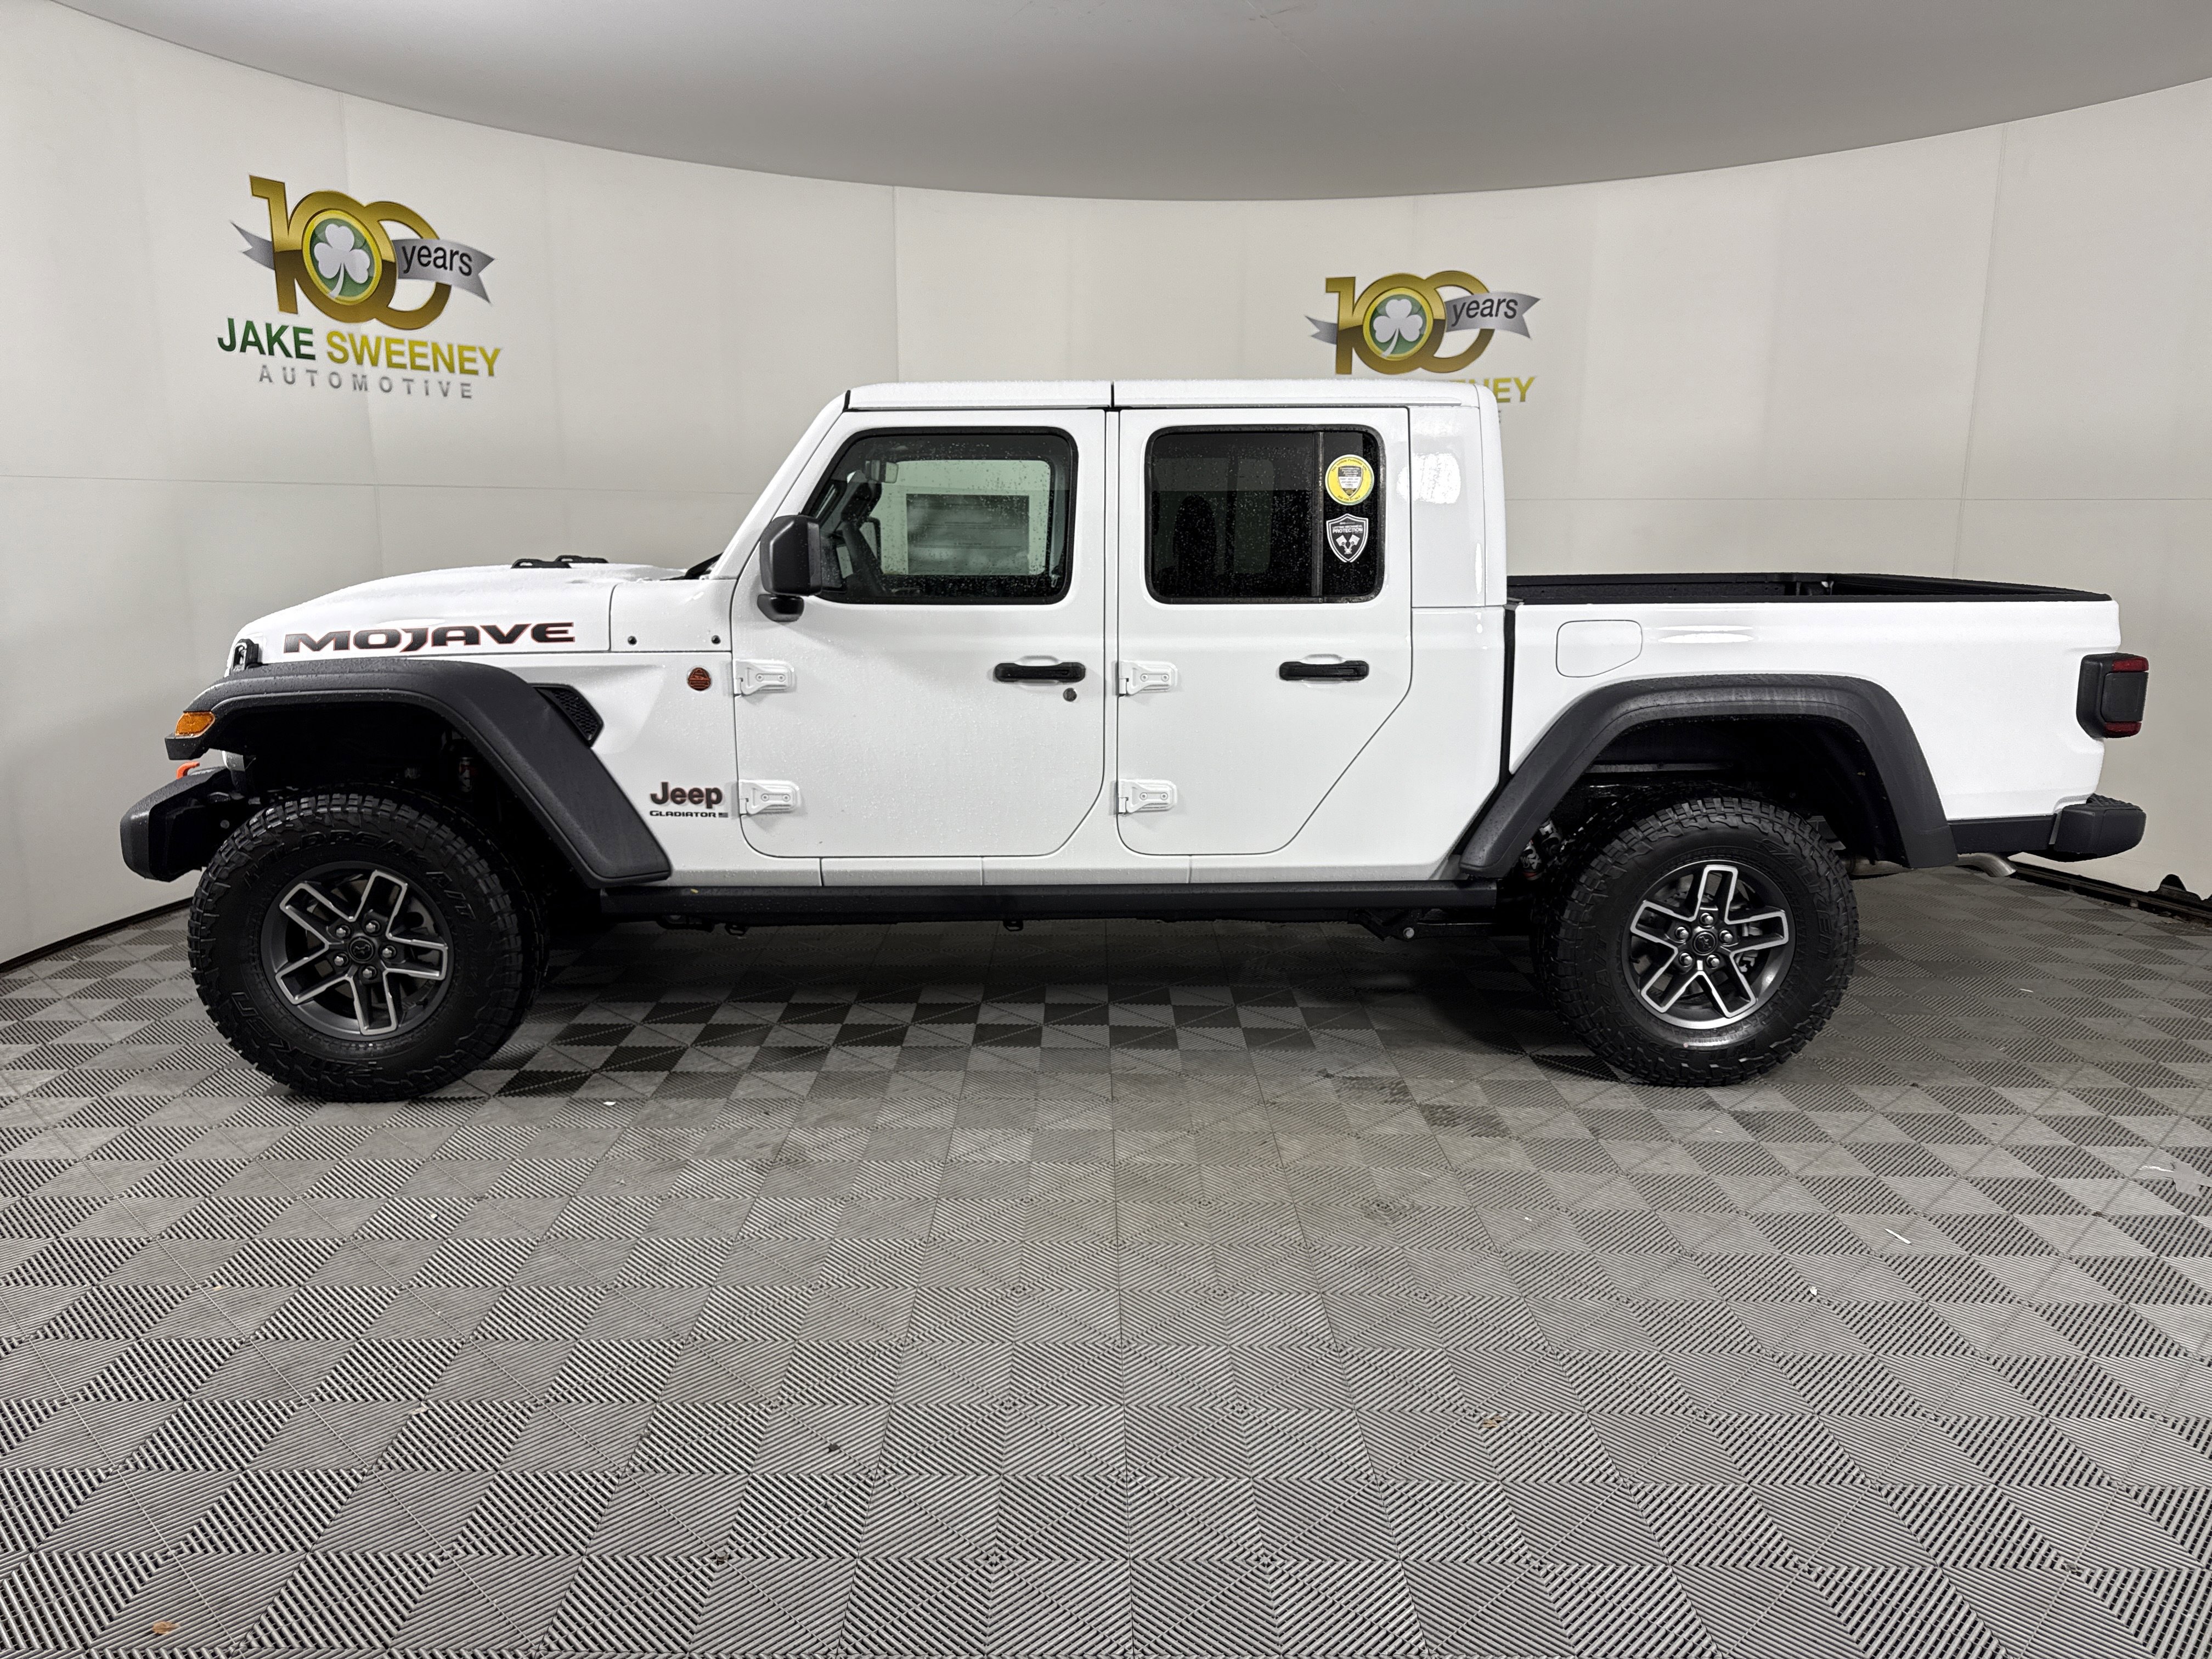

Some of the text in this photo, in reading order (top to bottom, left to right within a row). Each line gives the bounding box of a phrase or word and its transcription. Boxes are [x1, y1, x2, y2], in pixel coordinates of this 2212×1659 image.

[249, 174, 452, 330] 100
[402, 245, 473, 276] years
[1325, 270, 1496, 375] 100
[1451, 298, 1518, 328] years
[217, 317, 501, 377] JAKE SWEENEY
[259, 364, 472, 399] AUTOMOTIVE
[284, 622, 576, 653] MOJAVE
[650, 782, 723, 809] Jeep
